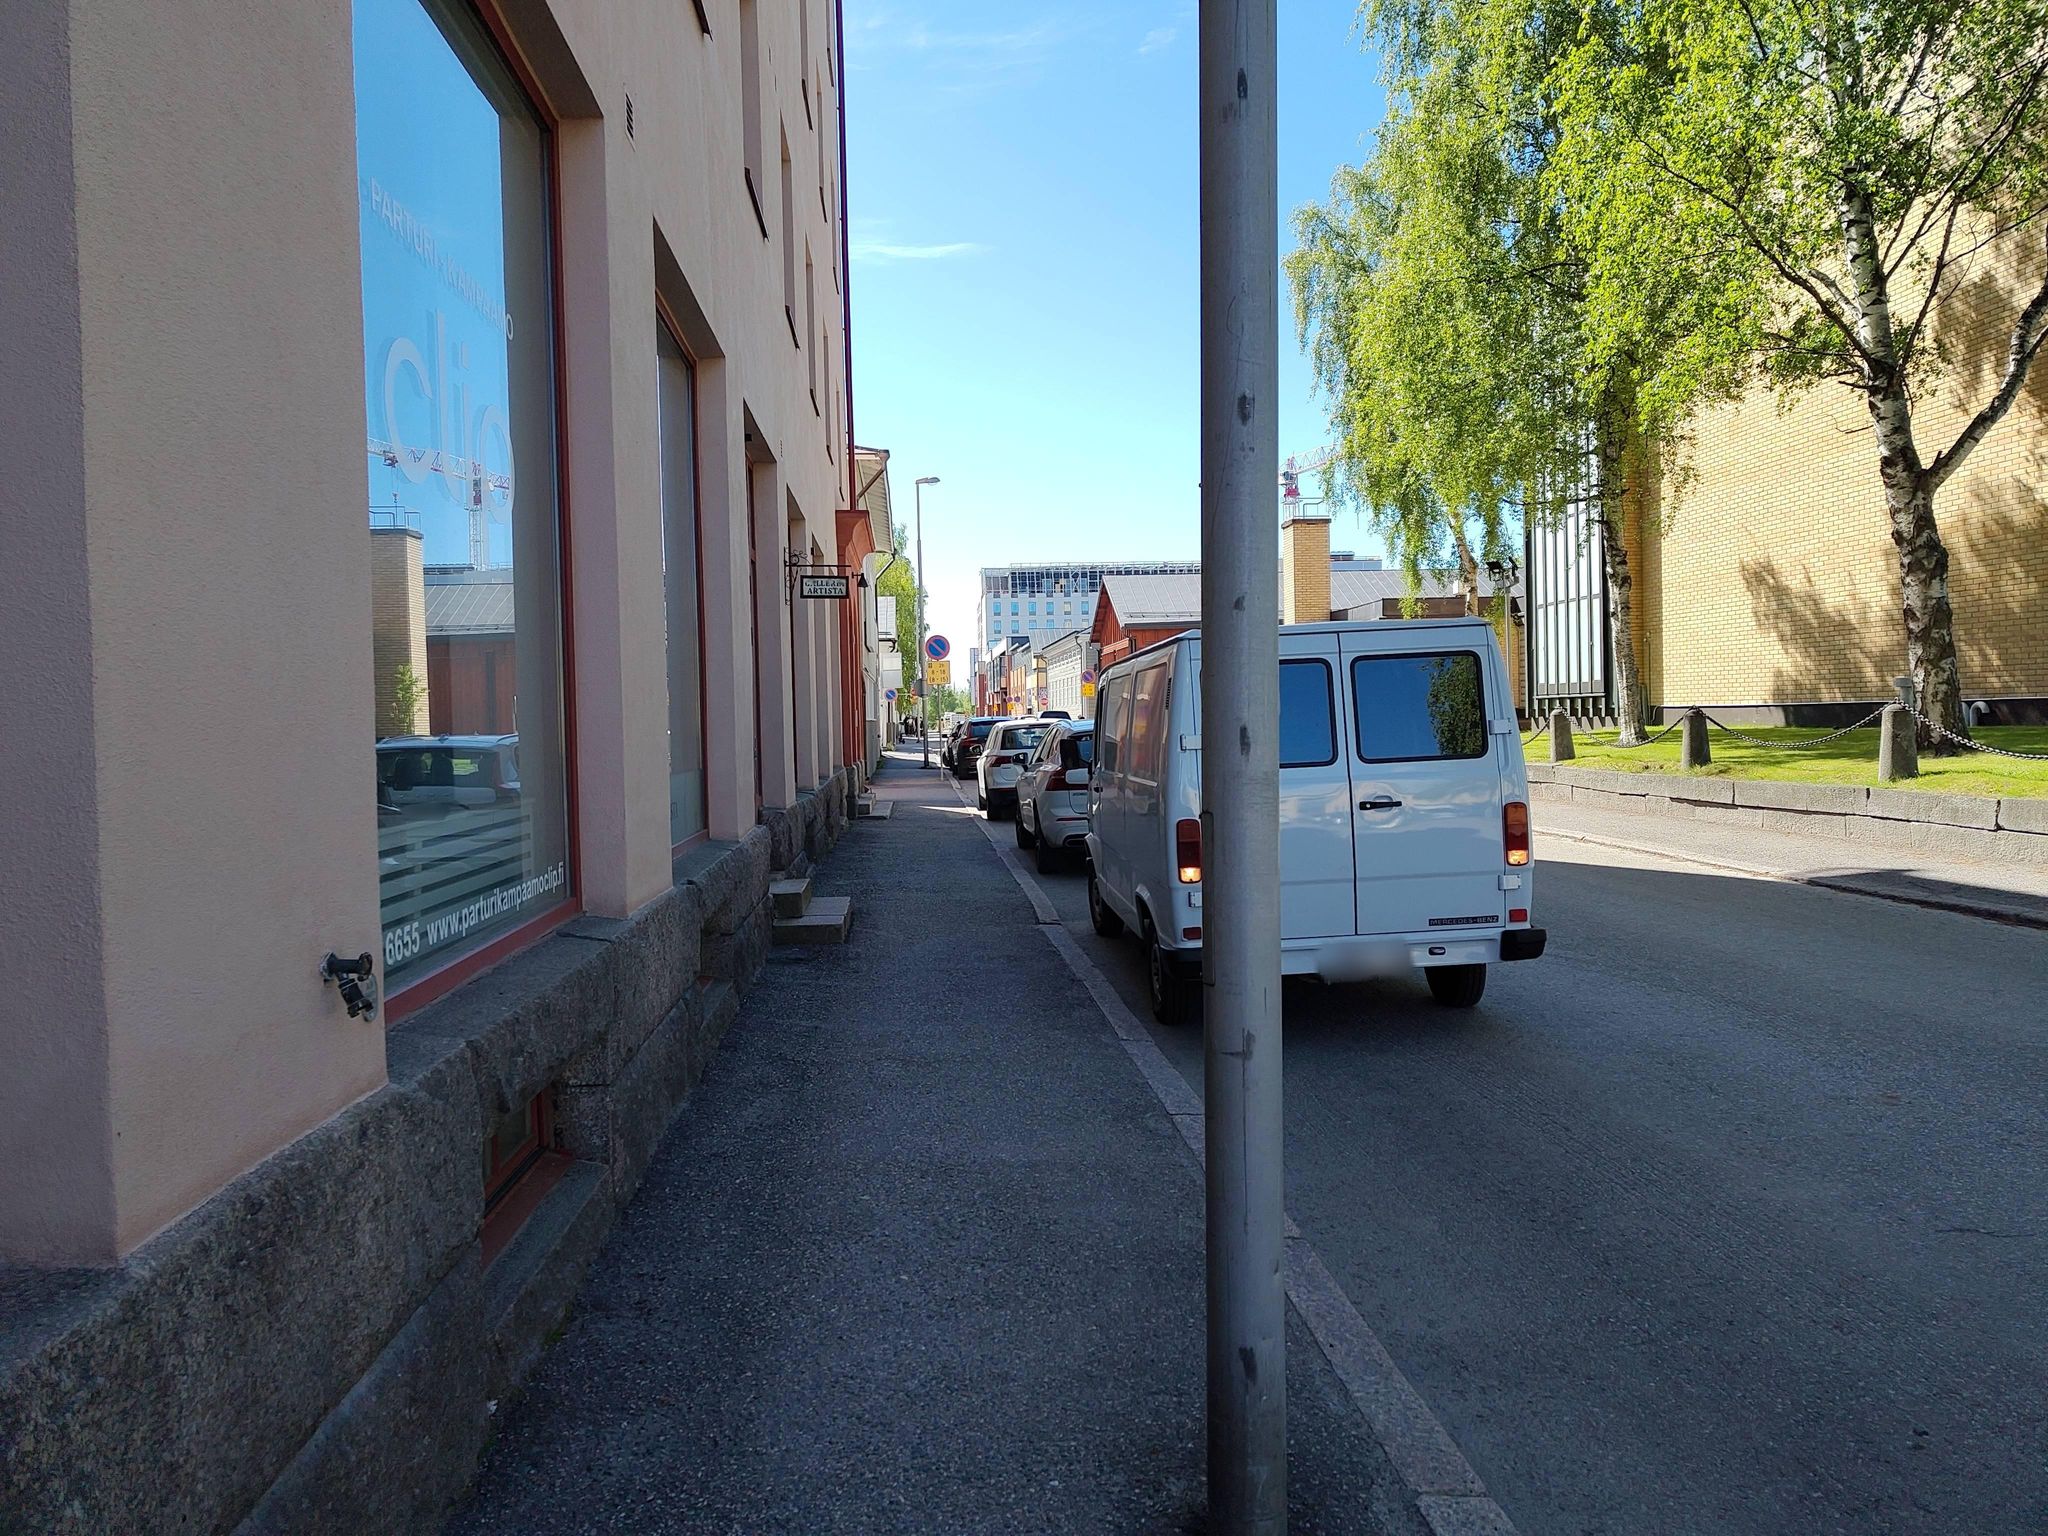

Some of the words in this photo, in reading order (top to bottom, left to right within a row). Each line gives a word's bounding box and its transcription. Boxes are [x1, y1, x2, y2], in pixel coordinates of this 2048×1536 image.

[385, 921, 420, 965] 6655
[427, 861, 564, 945] www.parturikampaamoclip.fi
[1430, 916, 1497, 925] MERCEDES-BENZ
